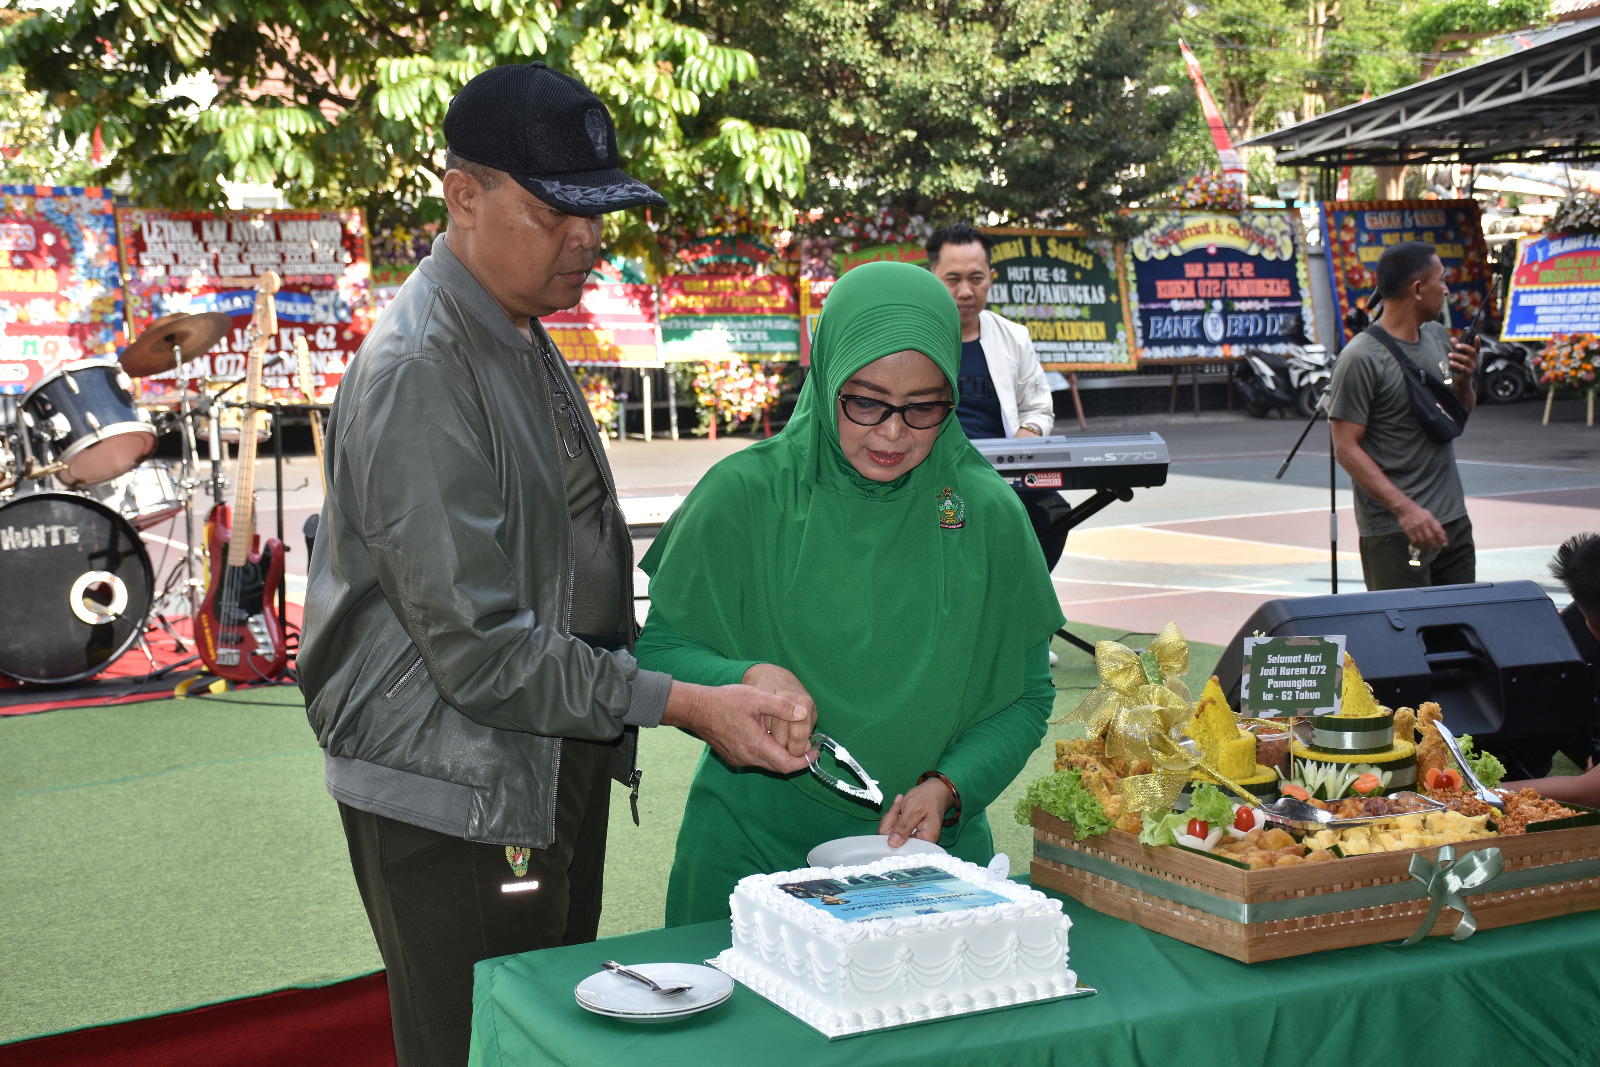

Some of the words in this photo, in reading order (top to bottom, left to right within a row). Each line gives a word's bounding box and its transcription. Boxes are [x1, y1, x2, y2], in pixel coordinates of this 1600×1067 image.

[1007, 266, 1031, 281] HUT
[1033, 267, 1068, 282] KE-62
[1149, 315, 1202, 340] BANK
[1226, 314, 1263, 338] BPD
[215, 354, 246, 376] 072
[1267, 654, 1302, 664] Selamat
[1304, 653, 1322, 663] Hari
[1260, 666, 1278, 676] Jadi
[1280, 667, 1307, 676] Korem
[1310, 665, 1327, 675] 072
[1267, 678, 1317, 689] Pamungkas
[1263, 692, 1273, 701] ke
[1281, 691, 1292, 701] 62
[1295, 691, 1320, 700] Tahun
